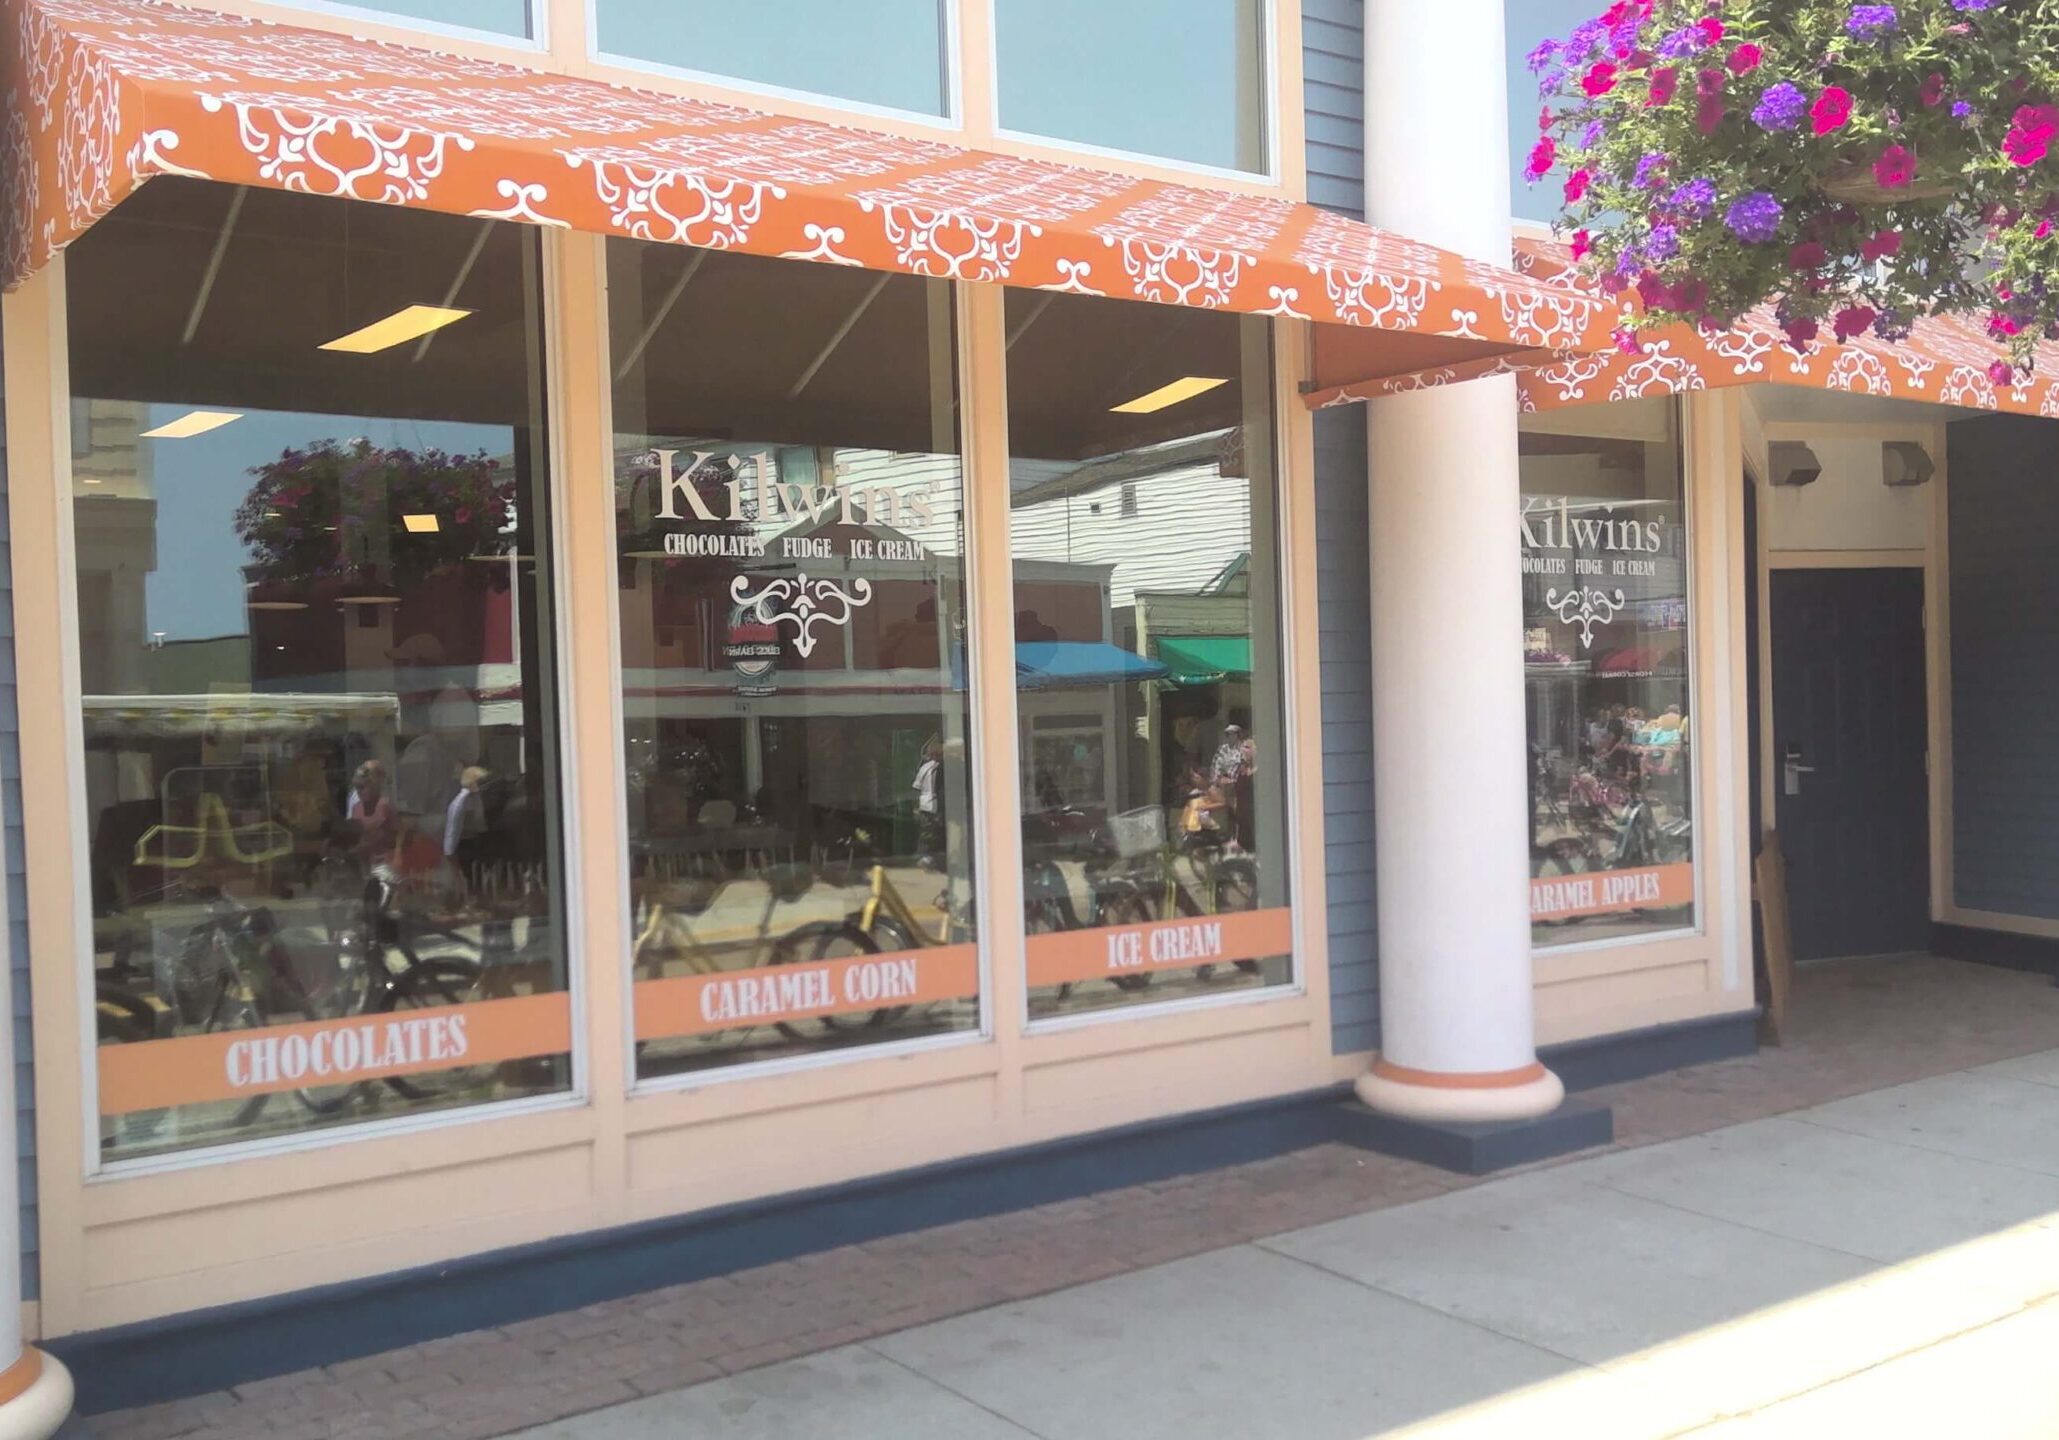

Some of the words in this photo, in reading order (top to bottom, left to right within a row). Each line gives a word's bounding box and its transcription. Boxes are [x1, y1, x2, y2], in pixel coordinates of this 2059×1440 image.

[664, 533, 765, 558] CHOCOLATES
[782, 537, 833, 559] FUDGE
[850, 538, 873, 560] ICE
[877, 539, 926, 561] CREAM
[1520, 557, 1566, 574] OCOLATES
[1575, 558, 1604, 575] FUDGE
[1612, 559, 1626, 576] ICE
[1628, 560, 1656, 577] CREAM
[1529, 879, 1597, 914] ARAMEL
[1601, 872, 1660, 906] APPLES
[1106, 930, 1143, 969] ICE
[1149, 921, 1222, 964] CREAM
[700, 969, 835, 1024] CARAMEL
[843, 958, 918, 1002] CORN
[225, 1013, 468, 1088] CHOCOLATES
